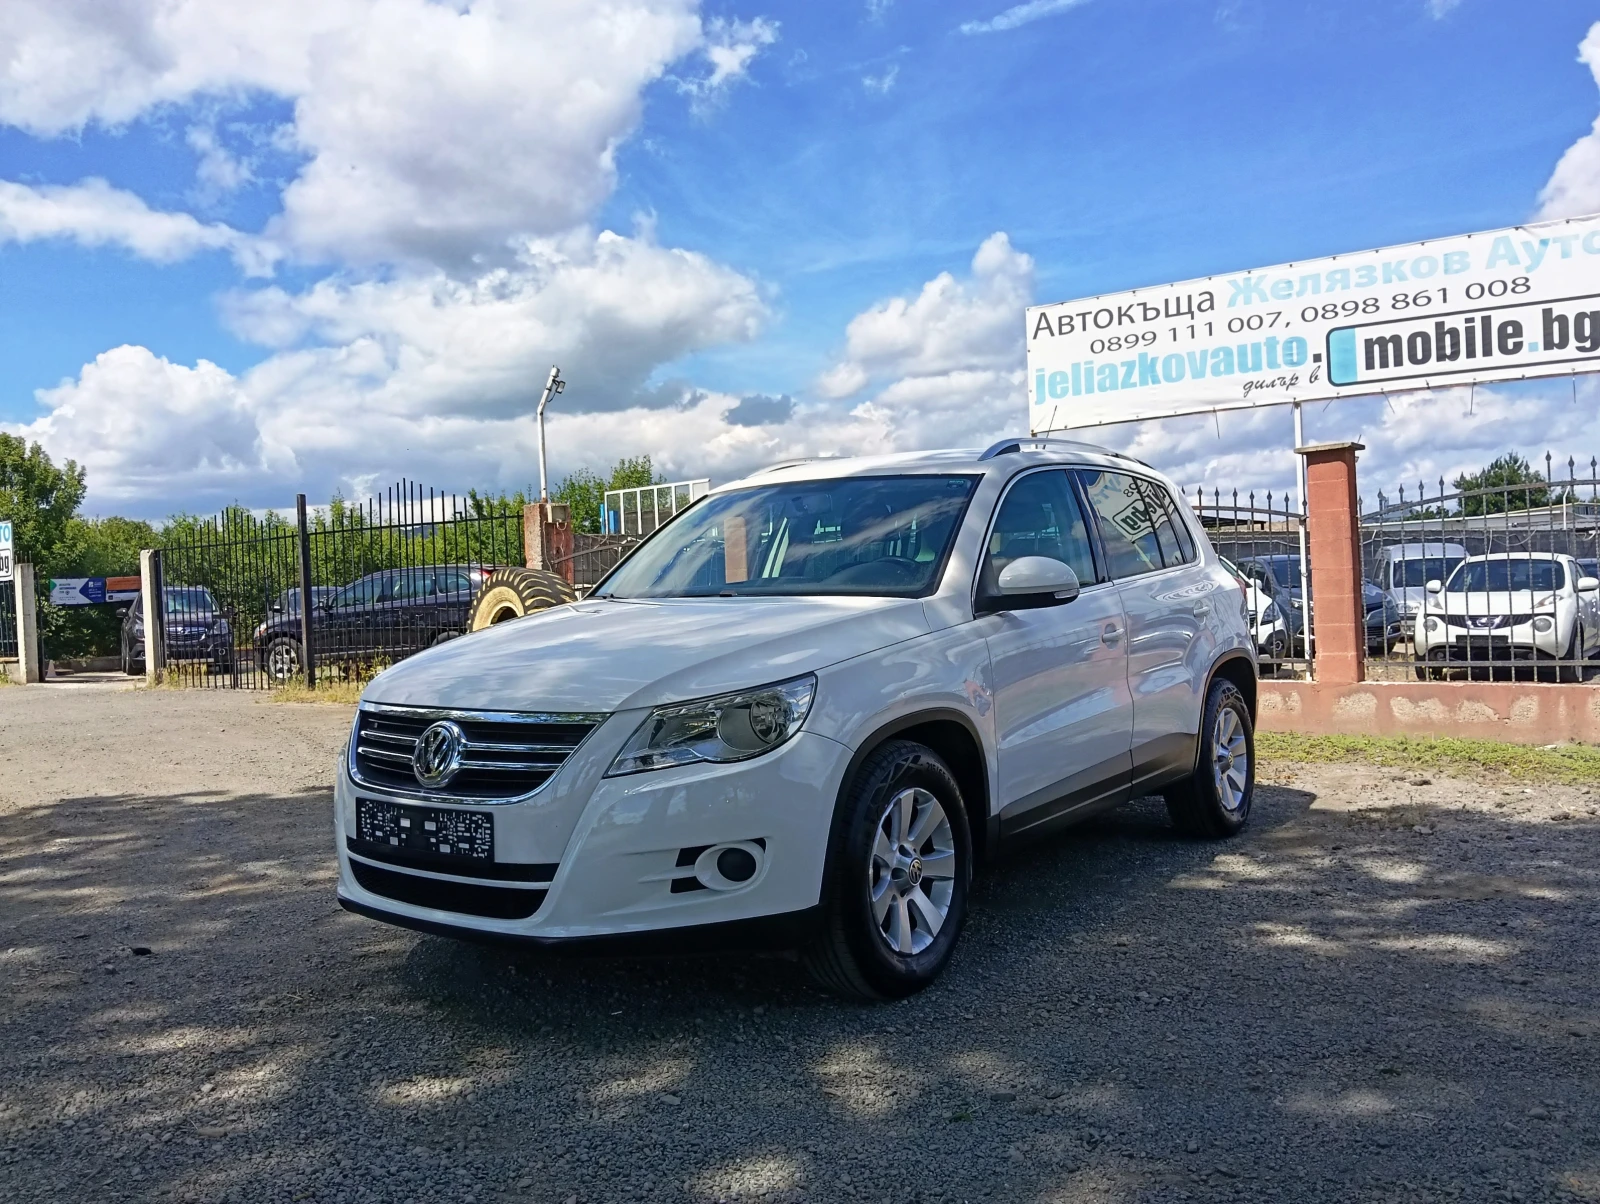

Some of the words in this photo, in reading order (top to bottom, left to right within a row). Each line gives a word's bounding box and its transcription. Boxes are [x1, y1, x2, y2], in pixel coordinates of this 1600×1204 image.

[1033, 290, 1215, 340] Автокъща
[1226, 250, 1471, 308] Желязков
[1485, 230, 1600, 274] Ауто
[1090, 331, 1157, 354] 0899
[1168, 321, 1213, 342] 111
[1227, 311, 1291, 333] 007,
[1301, 297, 1380, 323] 0898
[1391, 287, 1448, 310] 861
[1465, 276, 1531, 300] 008
[1364, 307, 1600, 371] mobile.bg
[1243, 372, 1300, 398] дилър
[1309, 365, 1321, 384] в
